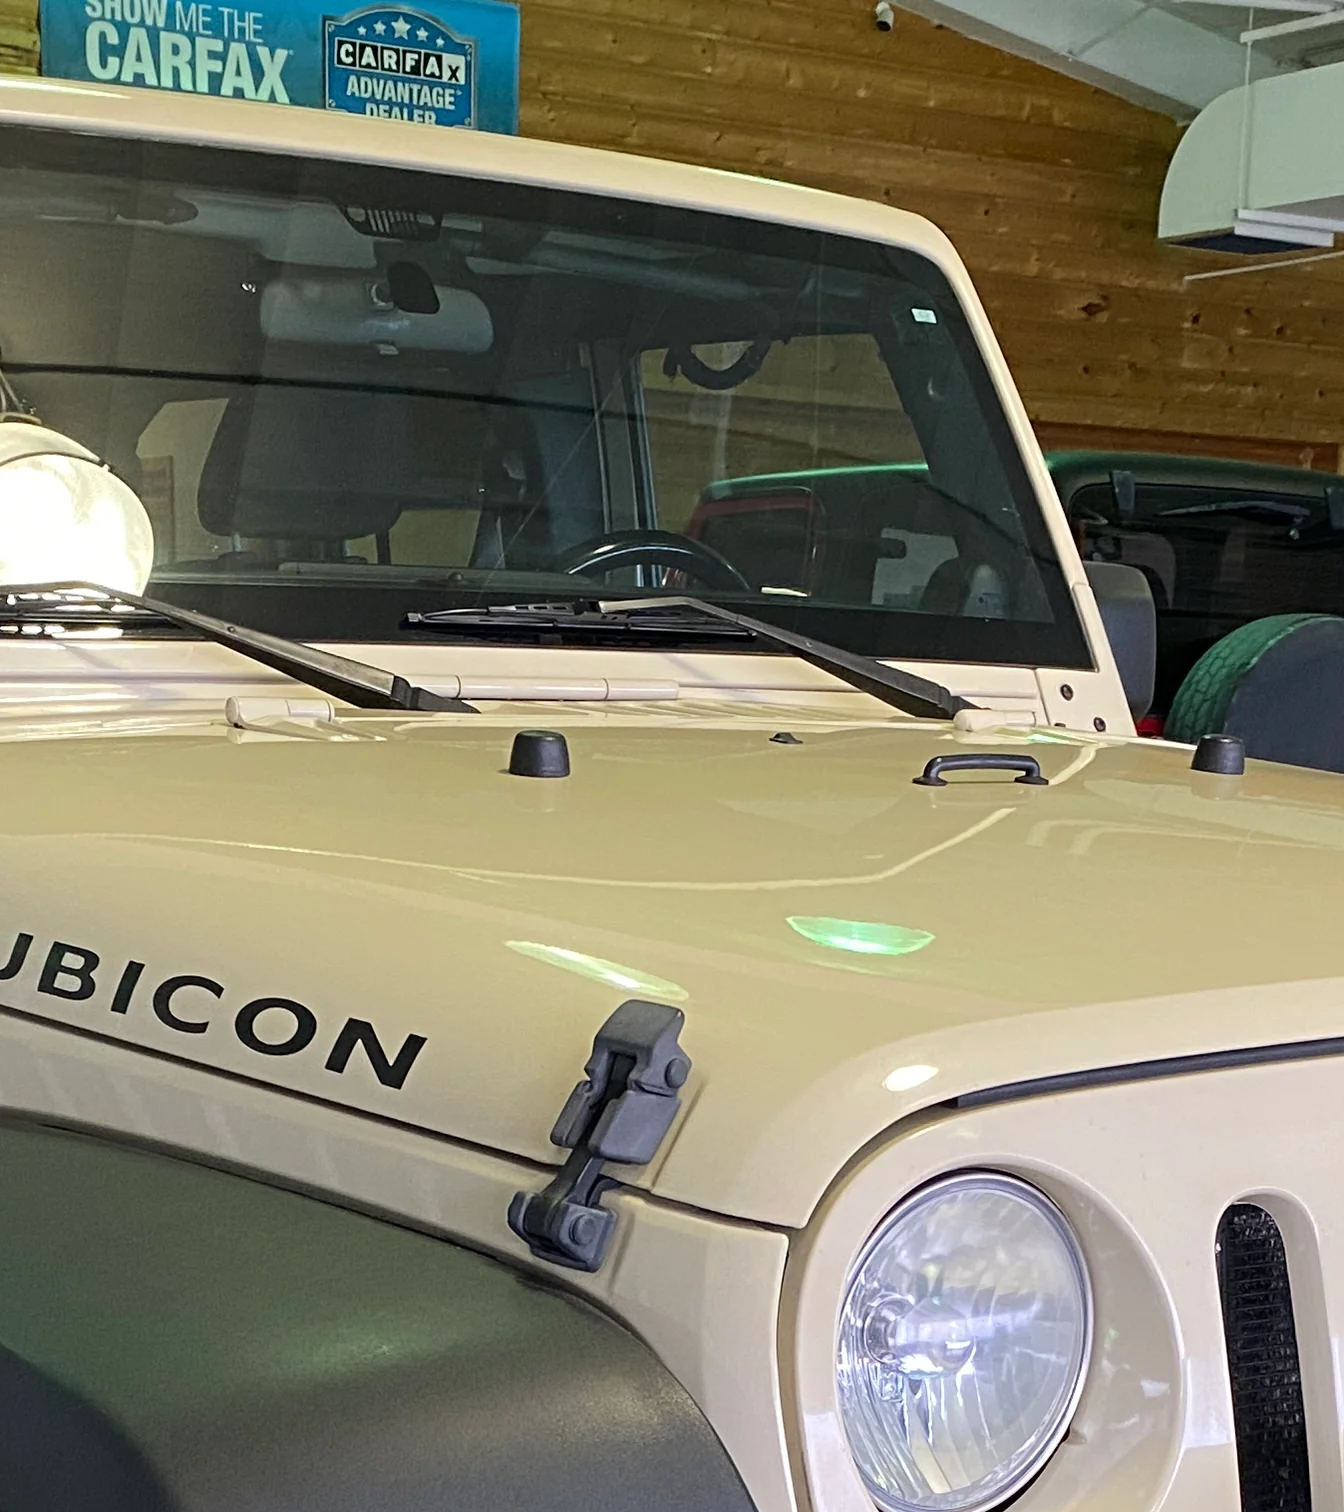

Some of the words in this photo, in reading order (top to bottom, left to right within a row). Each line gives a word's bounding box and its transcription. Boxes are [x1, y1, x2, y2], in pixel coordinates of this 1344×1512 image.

[85, 0, 167, 28] SHOW
[175, 1, 213, 35] ME
[218, 7, 264, 43] THE
[85, 20, 292, 104] CARFAX
[339, 42, 461, 82] CARFAX
[346, 75, 456, 110] ADVANTAGE
